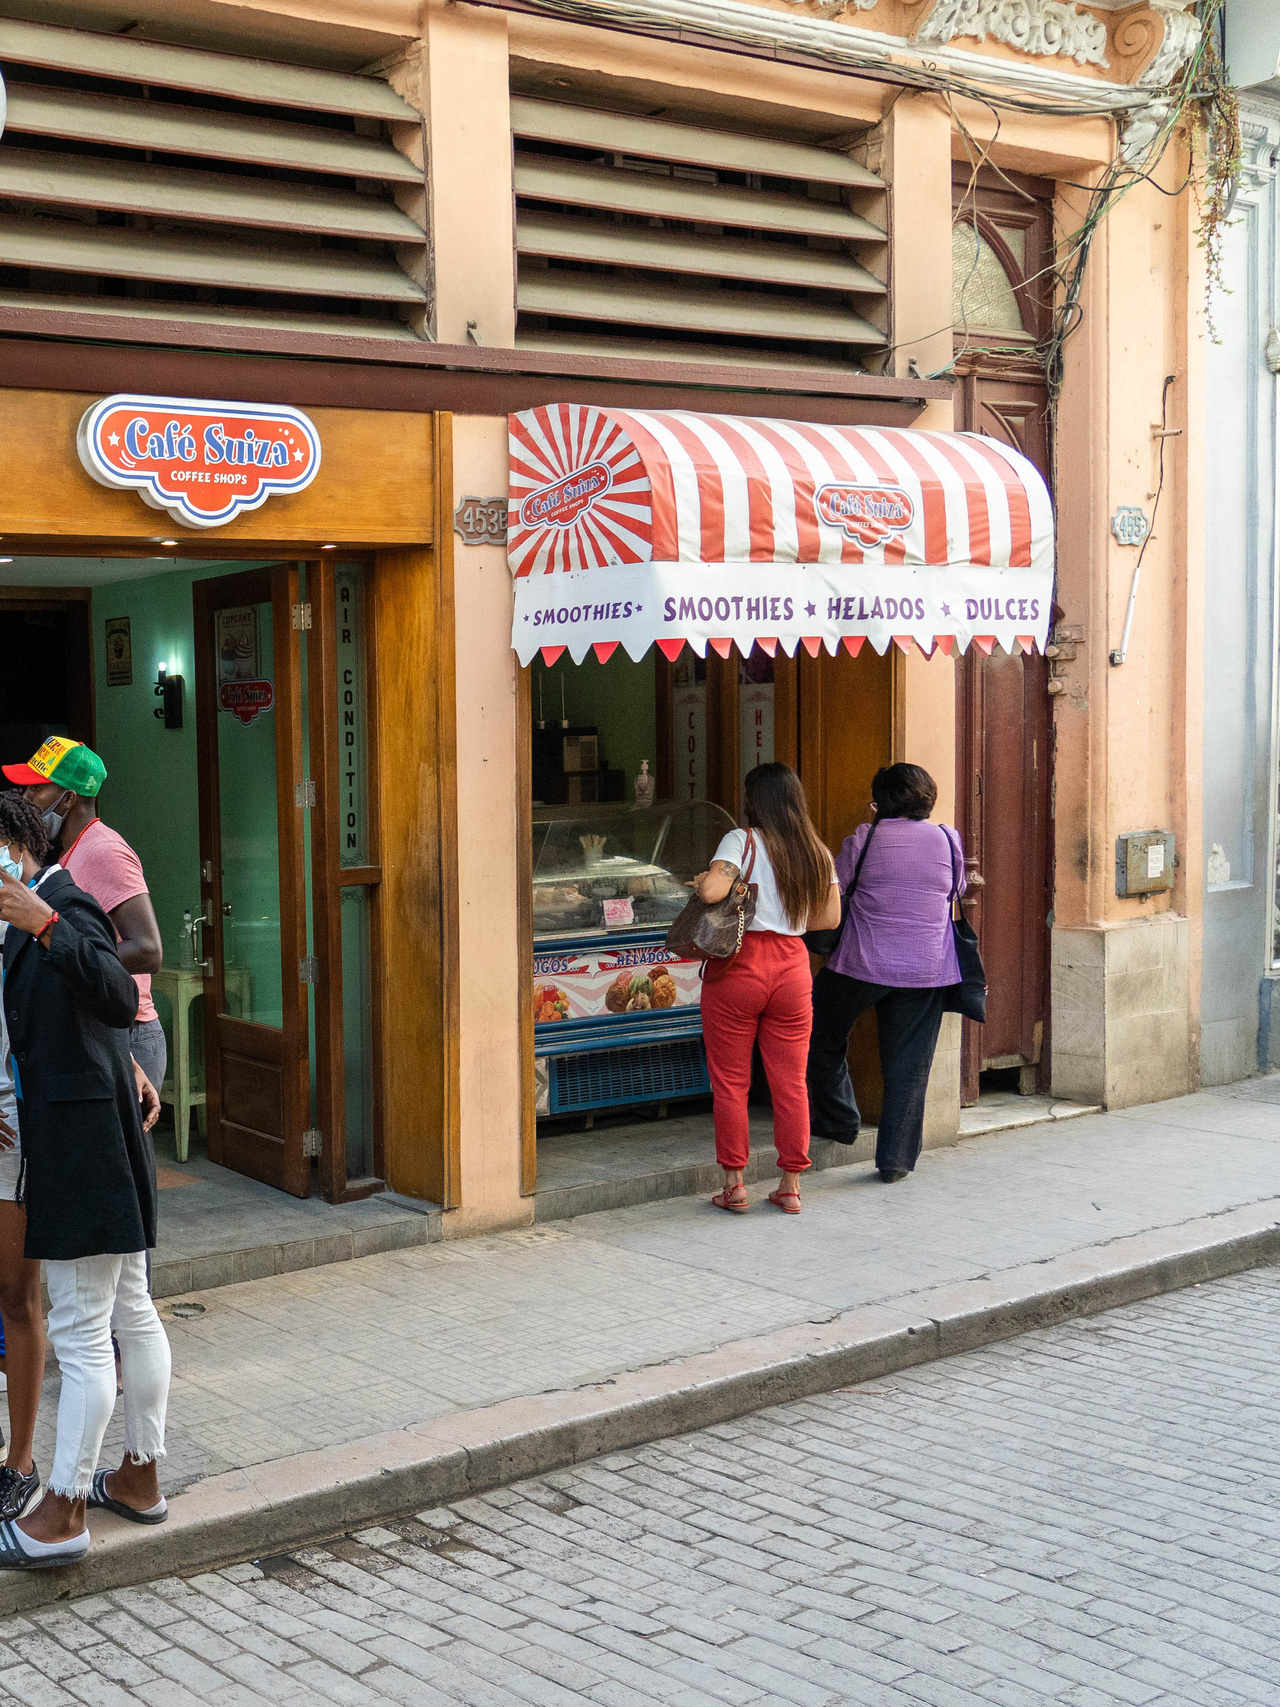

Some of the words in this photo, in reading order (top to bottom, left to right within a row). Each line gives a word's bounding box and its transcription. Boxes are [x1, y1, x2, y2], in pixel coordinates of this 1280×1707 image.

[125, 417, 196, 461] Café
[204, 423, 289, 467] Suiza
[171, 470, 211, 482] COFFEE
[214, 473, 247, 485] SHOPS
[532, 491, 561, 516] Café
[563, 476, 600, 503] Suiza
[830, 492, 862, 516] Café
[864, 494, 903, 518] Suiza
[1120, 515, 1141, 538] 455
[341, 586, 352, 644] AIR
[533, 601, 633, 626] SMOOTHIES
[664, 596, 794, 622] SMOOTHIES
[827, 596, 925, 620] HELADOS
[965, 598, 1039, 620] DULCES
[343, 669, 357, 848] CONDITION
